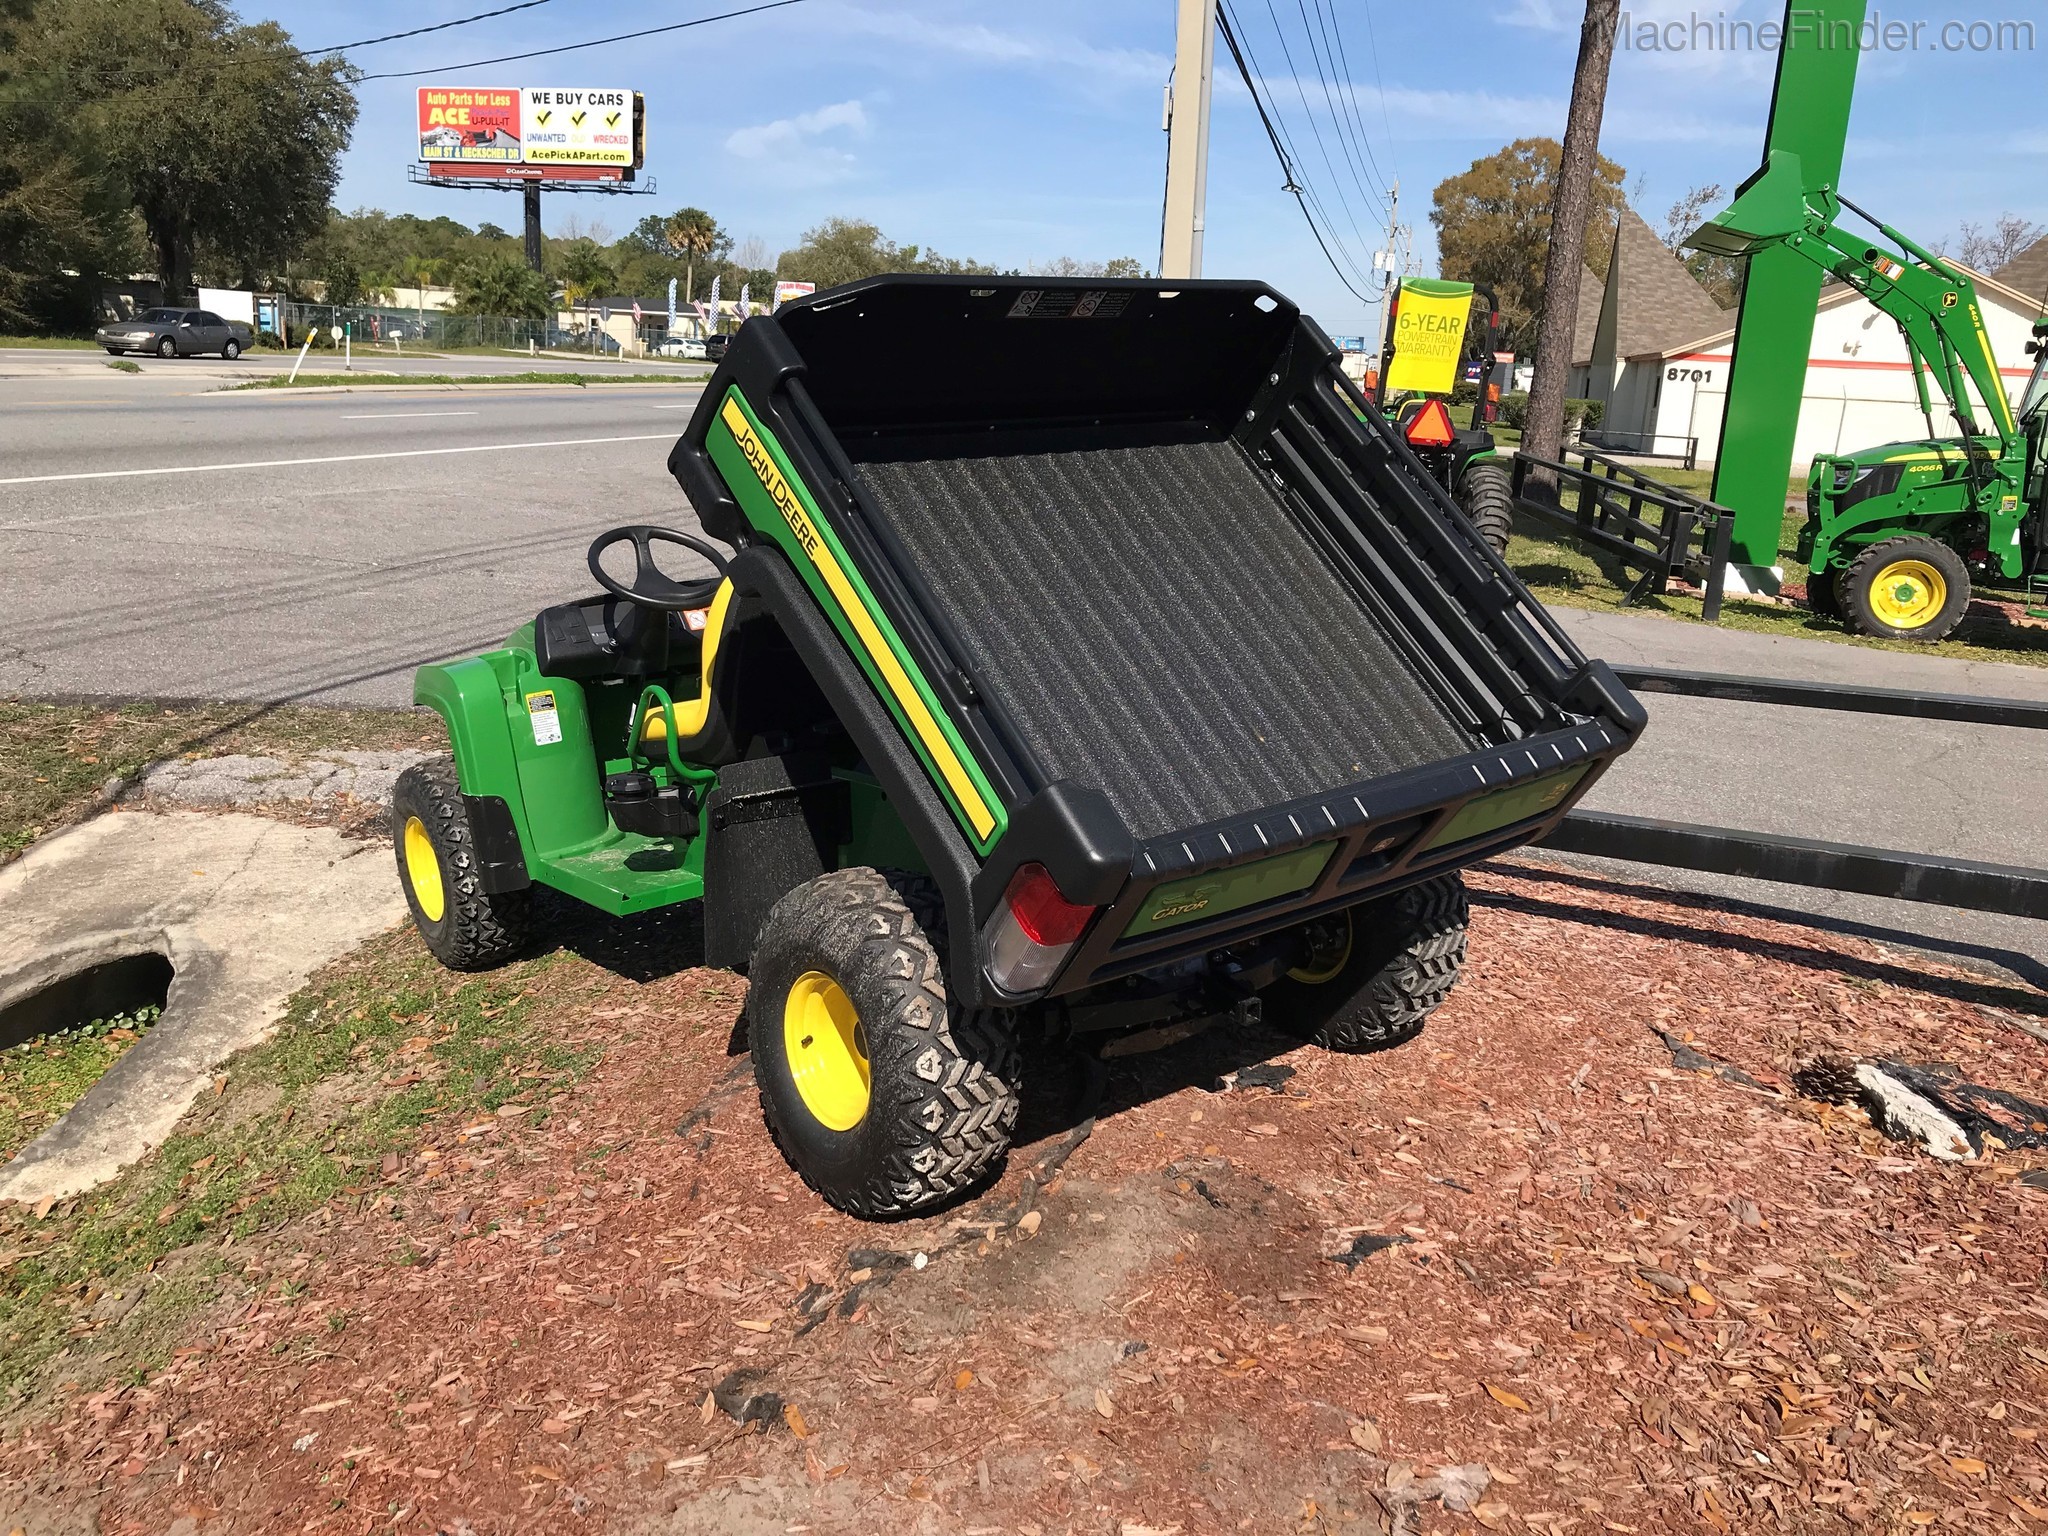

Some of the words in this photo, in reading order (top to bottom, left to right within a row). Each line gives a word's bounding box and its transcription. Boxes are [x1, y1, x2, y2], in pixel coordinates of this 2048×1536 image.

[427, 91, 447, 105] Auto
[449, 92, 473, 106] Parts
[474, 92, 488, 106] for
[490, 93, 511, 107] Less
[532, 92, 551, 105] WE
[556, 93, 583, 105] BUY
[588, 93, 624, 106] CARS
[428, 107, 471, 125] ACE
[471, 116, 510, 126] U-PULL-IT
[526, 133, 567, 143] UNWANTED
[593, 134, 629, 145] WRECKED
[423, 146, 443, 157] MAIN
[443, 147, 454, 158] ST
[508, 148, 519, 160] DR
[531, 150, 625, 161] AcePickAPart.com
[1399, 312, 1461, 335] 6-YEAR
[1397, 330, 1459, 346] POWERTRAIN
[1396, 342, 1456, 358] WARRANTY
[1667, 367, 1712, 383] 8701
[736, 427, 774, 487] JOHN
[772, 478, 819, 557] DEERE
[1152, 899, 1209, 921] GATOR
